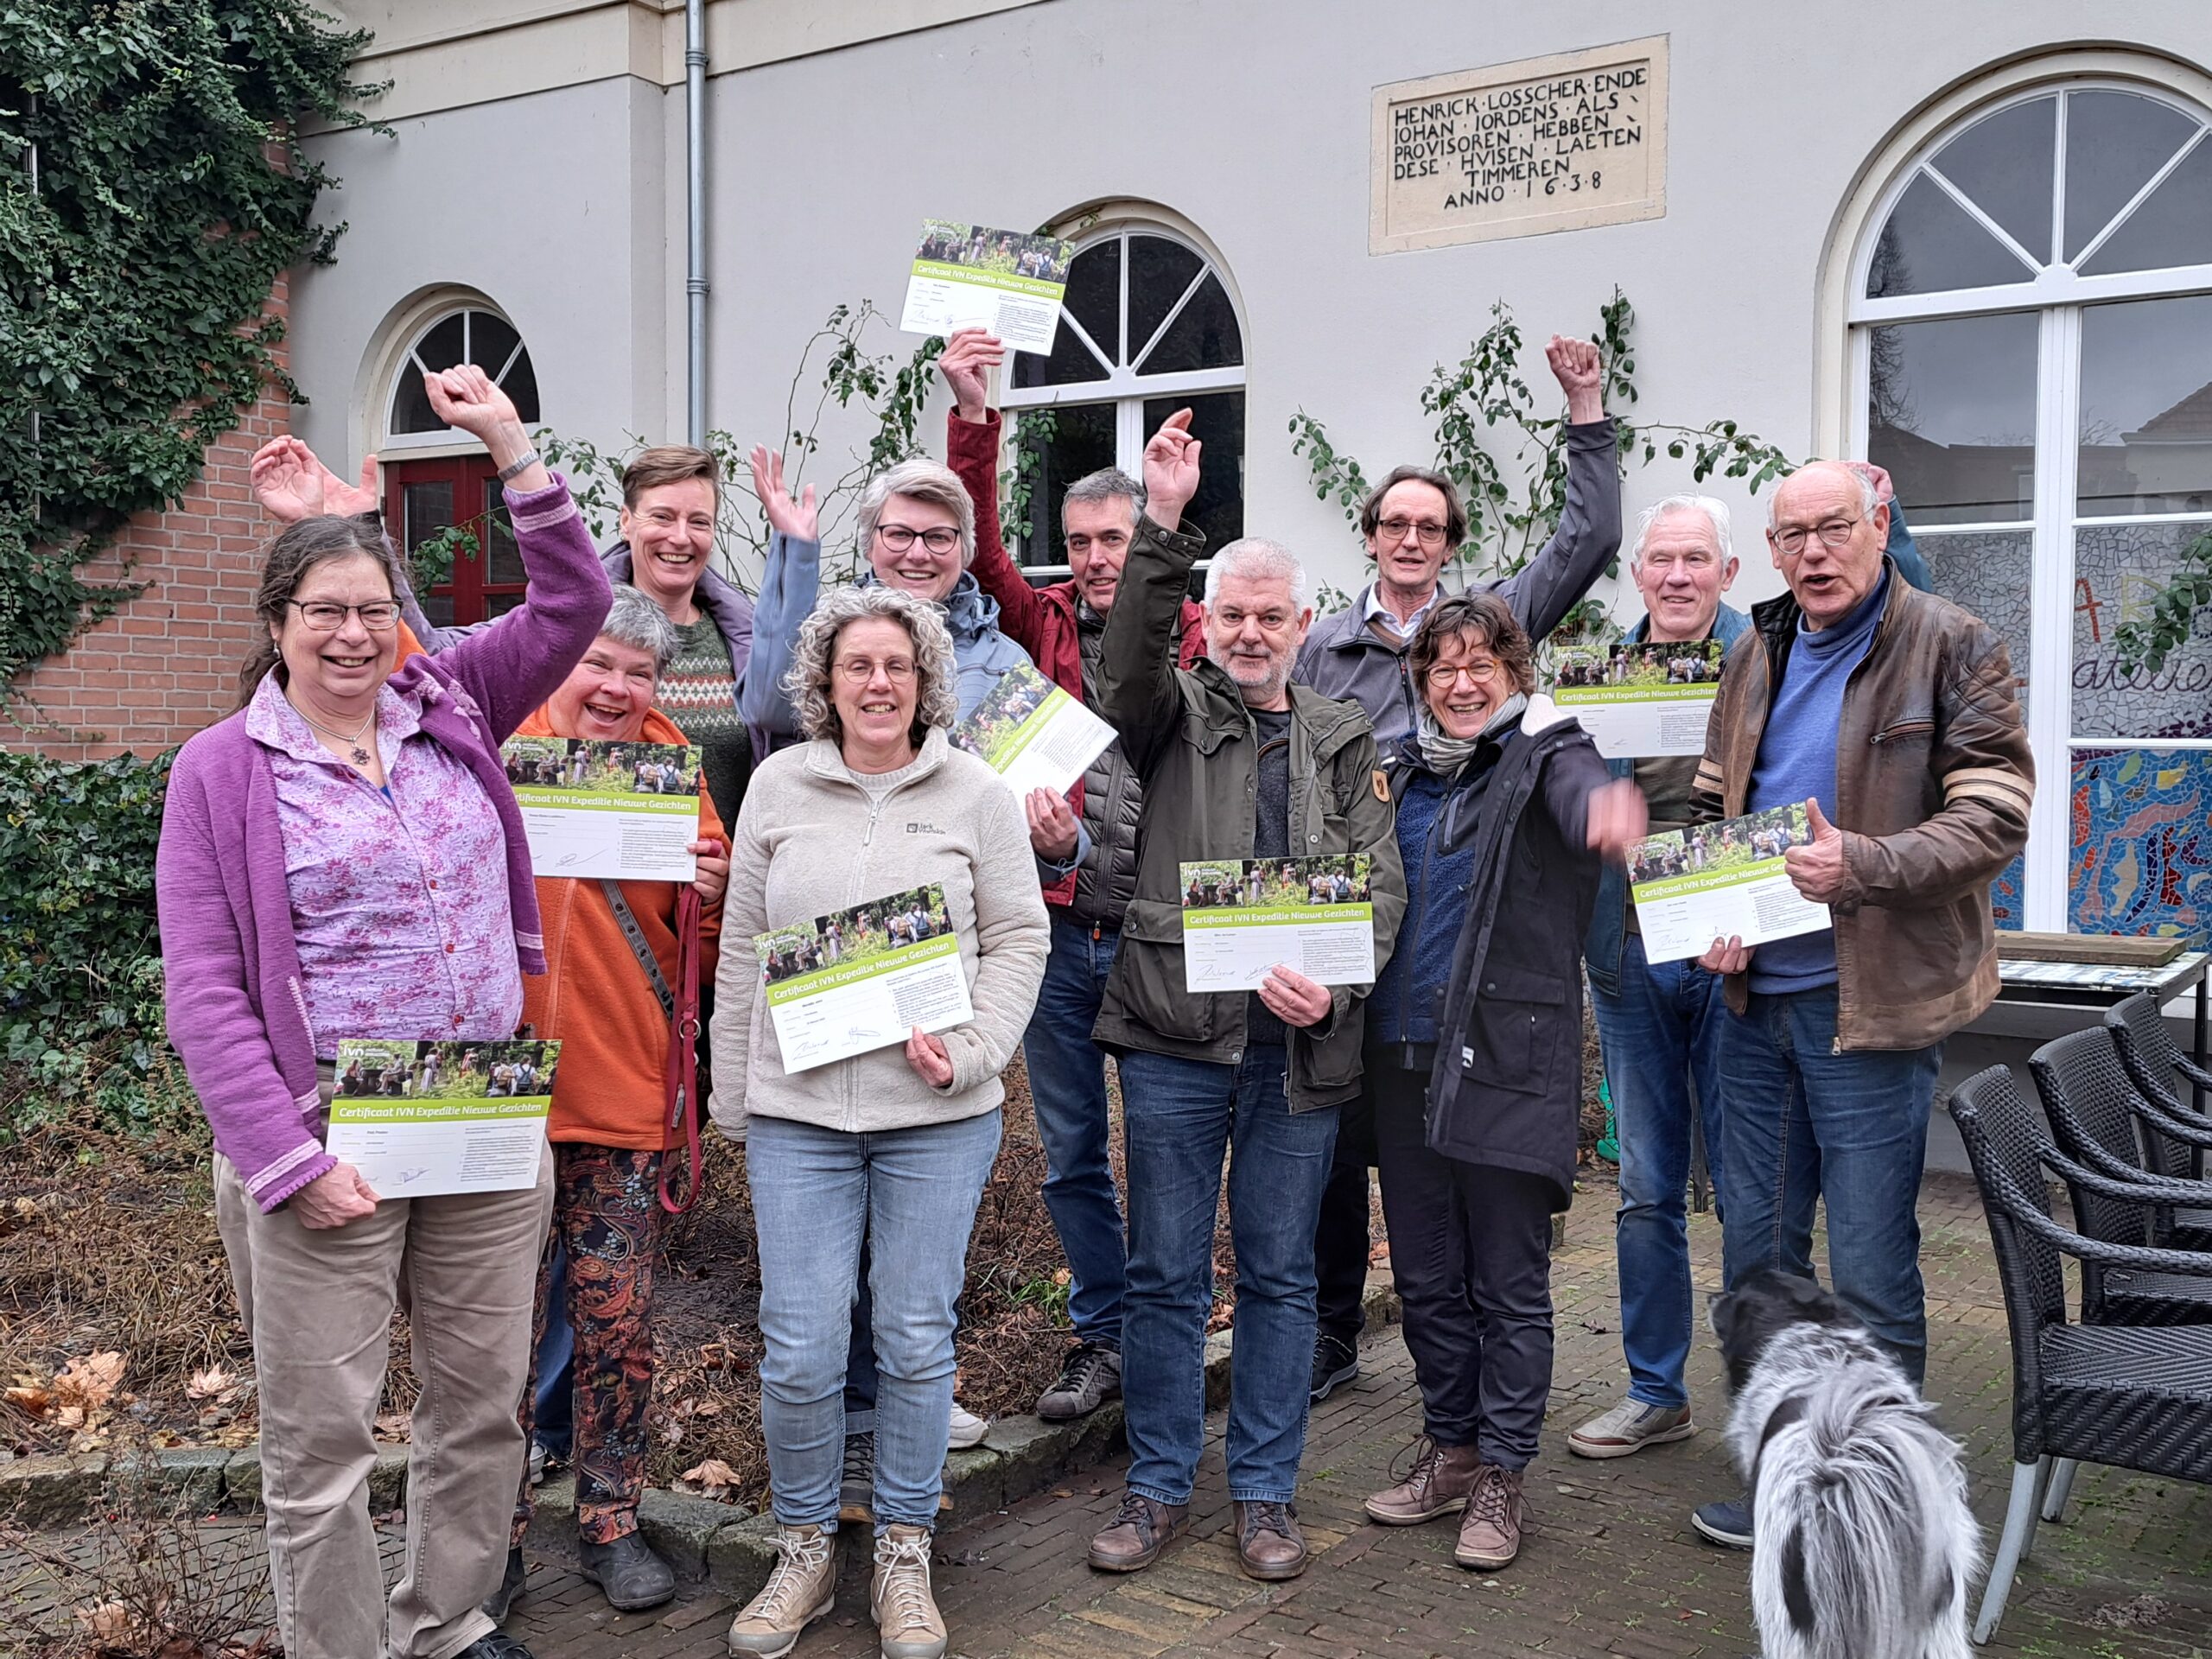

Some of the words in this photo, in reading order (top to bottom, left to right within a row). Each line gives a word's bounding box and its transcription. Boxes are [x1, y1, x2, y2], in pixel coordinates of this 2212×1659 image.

[1395, 96, 1478, 127] HENRICK
[1487, 79, 1587, 111] LOSSCHER
[1594, 67, 1648, 94] ENDE
[1576, 92, 1619, 115] ALS
[1394, 130, 1511, 163] PROVISOREN
[1533, 113, 1609, 141] HEBBEN
[1395, 158, 1440, 181] DESE
[1555, 125, 1642, 156] LAETEN
[1465, 156, 1570, 188] TIMMEREN
[1444, 185, 1505, 210] ANNO
[1560, 692, 1599, 702] Certificaat
[1616, 690, 1649, 700] Expeditie
[516, 793, 550, 802] rtificaat
[570, 796, 611, 805] Expeditie
[613, 798, 646, 807] Nieuwe
[648, 800, 690, 810] Gezichten
[1639, 883, 1683, 897] Certificaat
[1683, 880, 1699, 889] IVN
[1700, 873, 1738, 887] Expeditie
[1738, 866, 1770, 878] Nieuwe
[1189, 914, 1232, 924] Certificaat
[1251, 912, 1289, 922] Expeditie
[1323, 908, 1363, 918] Gezichten
[773, 980, 818, 999] Certificaat
[818, 975, 834, 985] IVN
[836, 964, 874, 981] Expeditie
[875, 955, 907, 969] Nieuwe
[908, 942, 949, 959] Gezichten
[339, 1107, 393, 1118] Certificaat
[396, 1107, 414, 1116] IVN
[416, 1106, 461, 1117] Expeditie
[461, 1105, 497, 1114] Nieuwe
[499, 1103, 541, 1112] Gezichten
